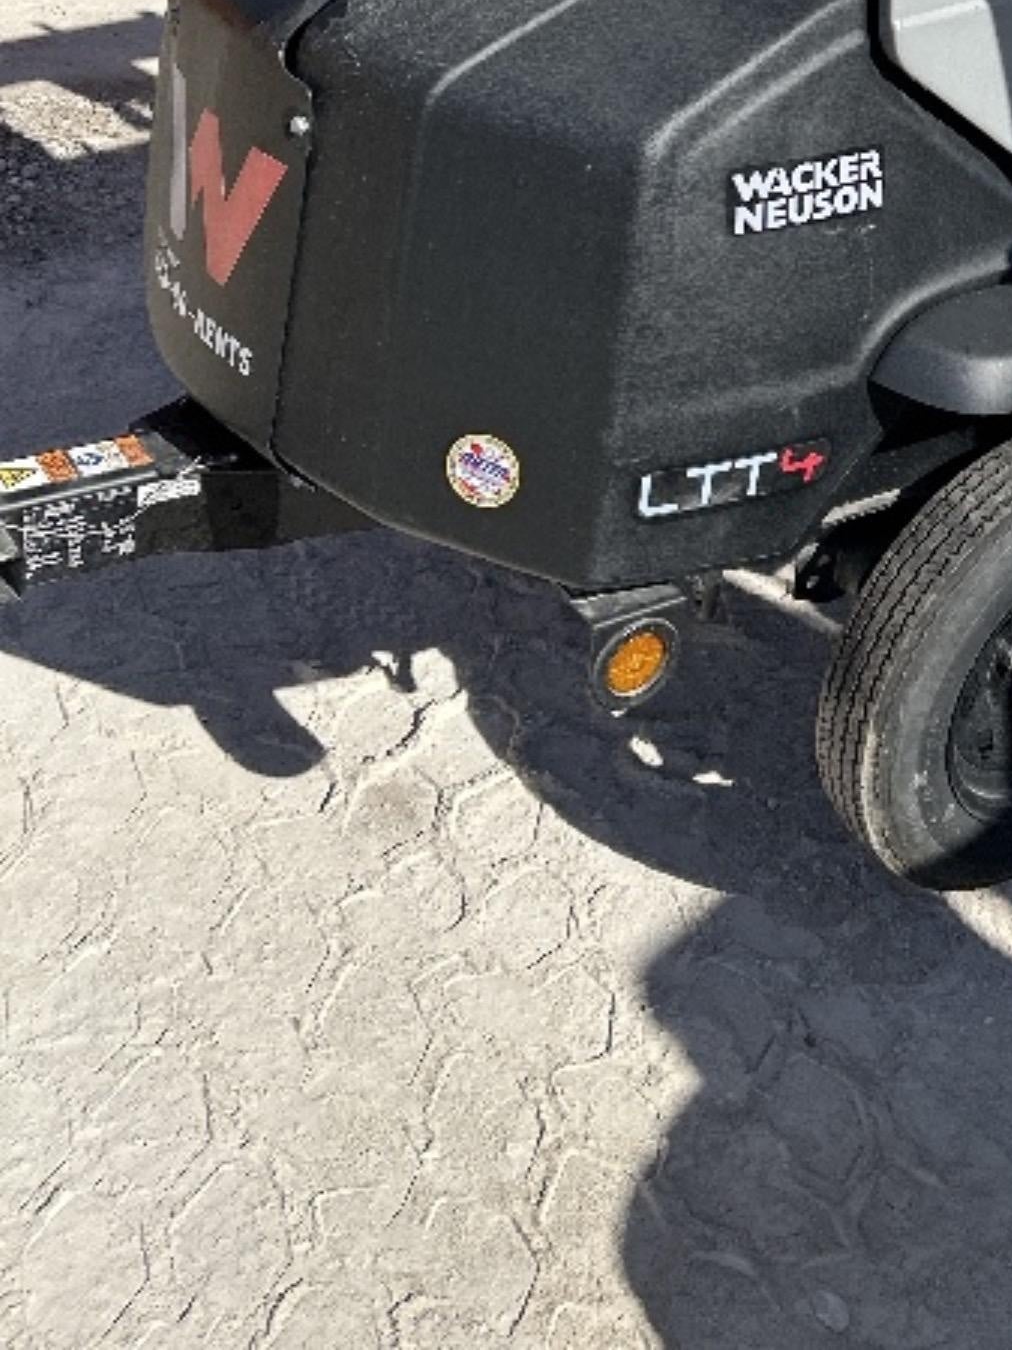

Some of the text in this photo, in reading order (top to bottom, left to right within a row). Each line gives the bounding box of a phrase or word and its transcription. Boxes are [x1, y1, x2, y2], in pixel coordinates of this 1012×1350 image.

[731, 149, 883, 202] WACKER
[733, 179, 884, 236] NEUSON
[638, 447, 825, 518] LTT4
